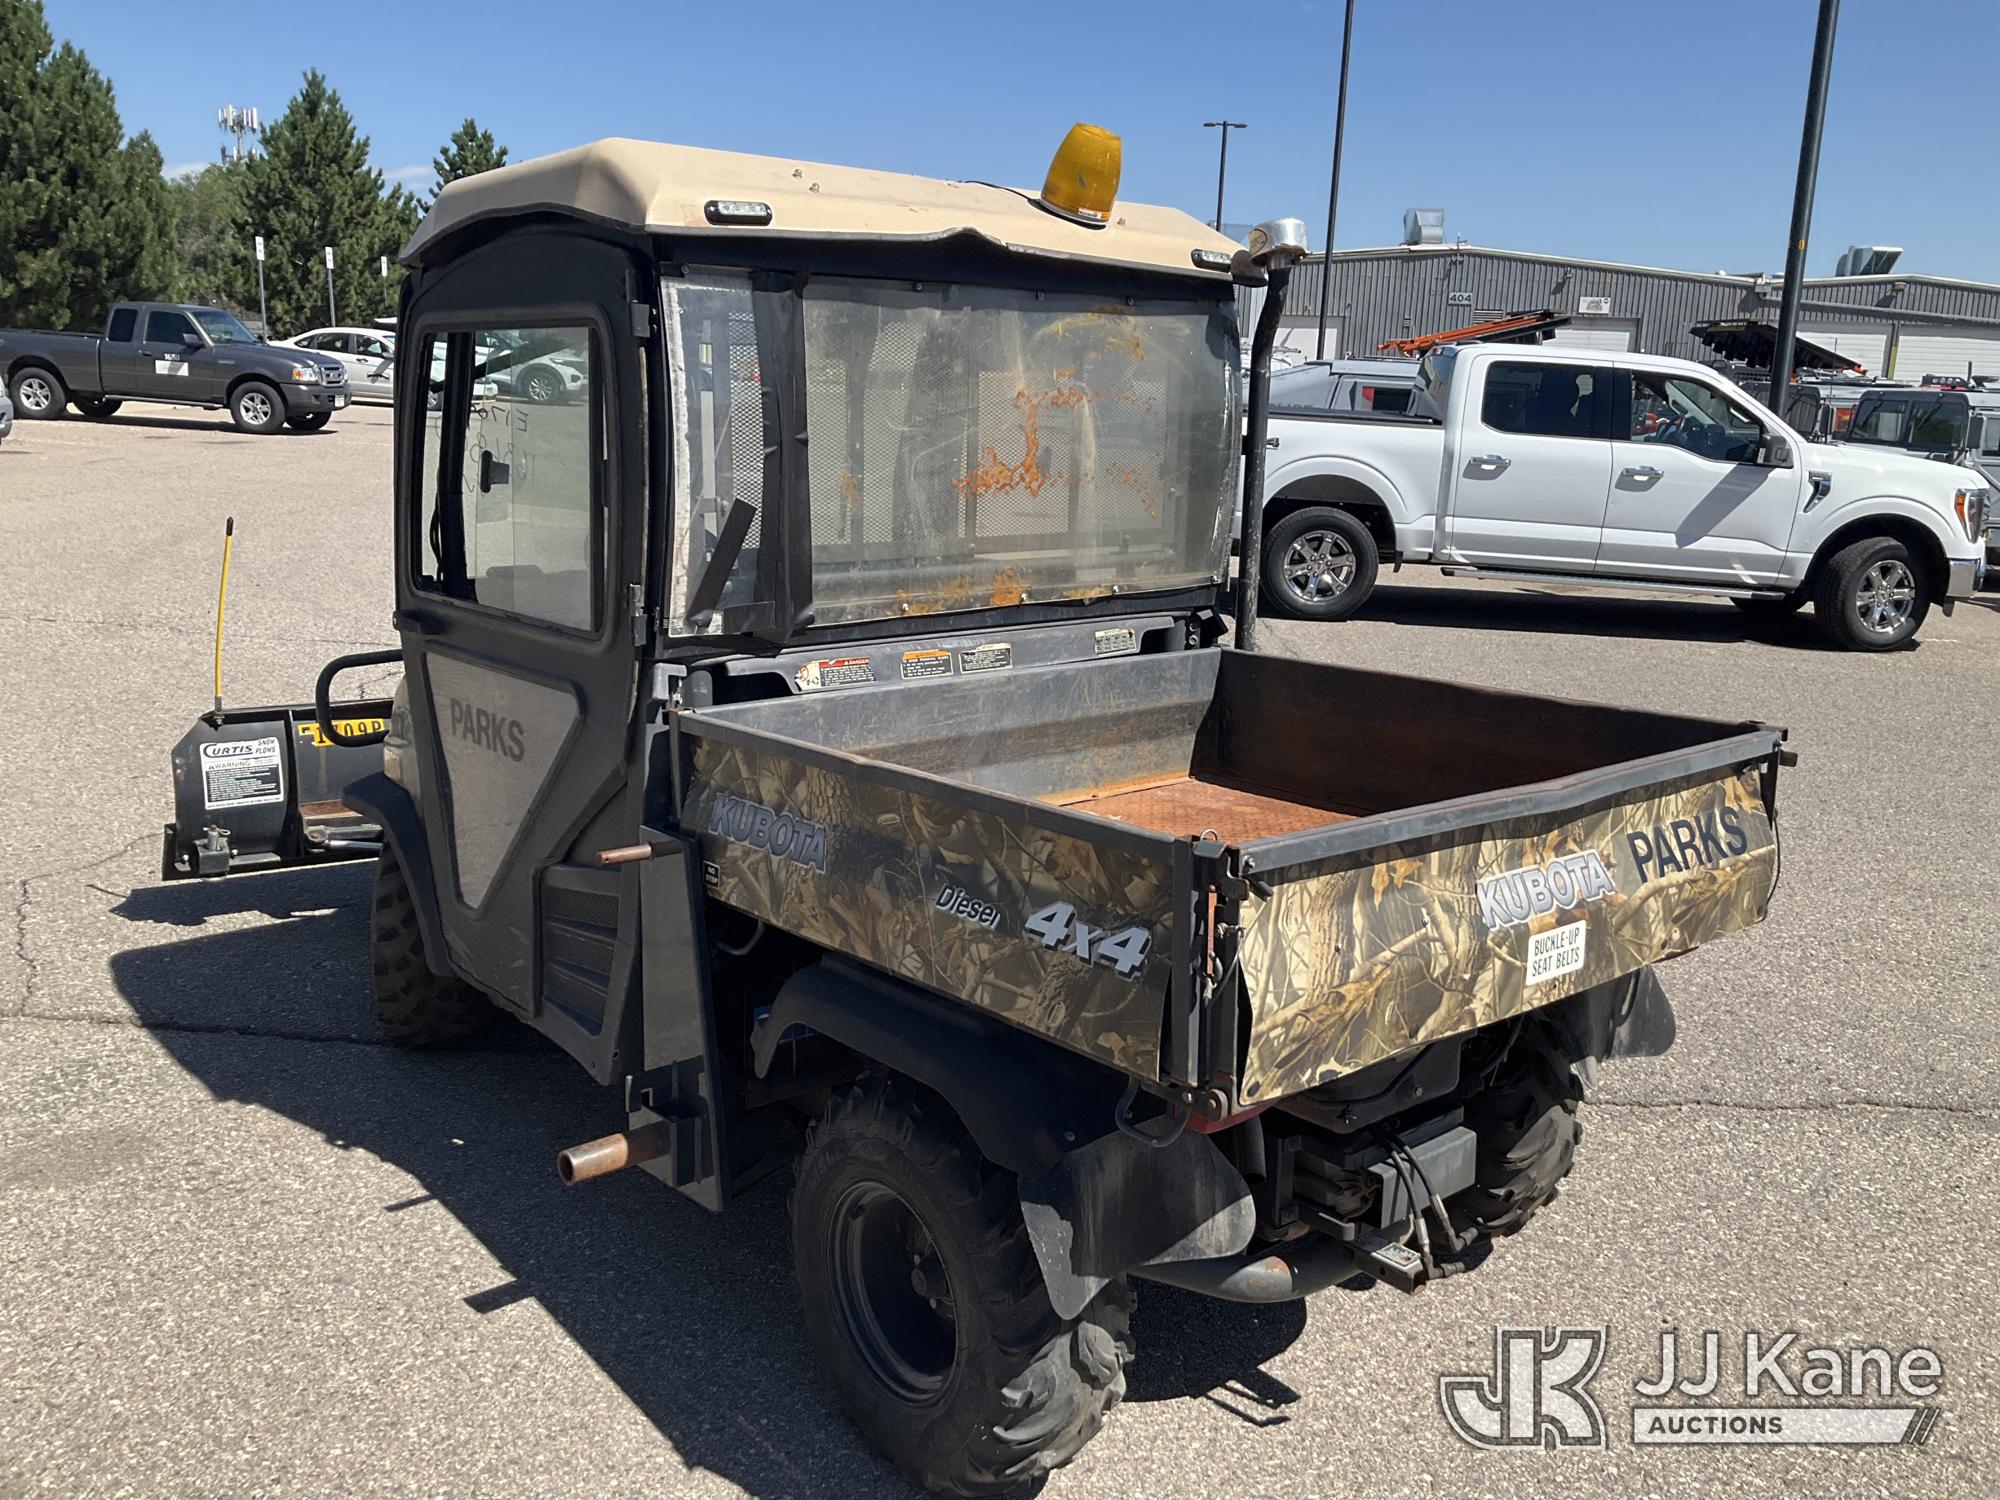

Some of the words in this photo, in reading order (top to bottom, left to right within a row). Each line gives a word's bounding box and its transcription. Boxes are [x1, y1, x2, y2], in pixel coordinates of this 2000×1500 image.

[1449, 294, 1472, 303] 404
[449, 698, 525, 763] PARKS
[202, 743, 254, 759] CURTIS
[215, 760, 252, 770] WARNING
[708, 792, 828, 874] KUBOTA
[1627, 805, 1748, 884] PARKS
[936, 883, 1001, 930] Diesel
[1476, 849, 1616, 931] KUBOTA
[1532, 955, 1553, 977] SEAT
[1556, 946, 1580, 969] BELTS
[1534, 927, 1580, 957] BUCKLE-UP
